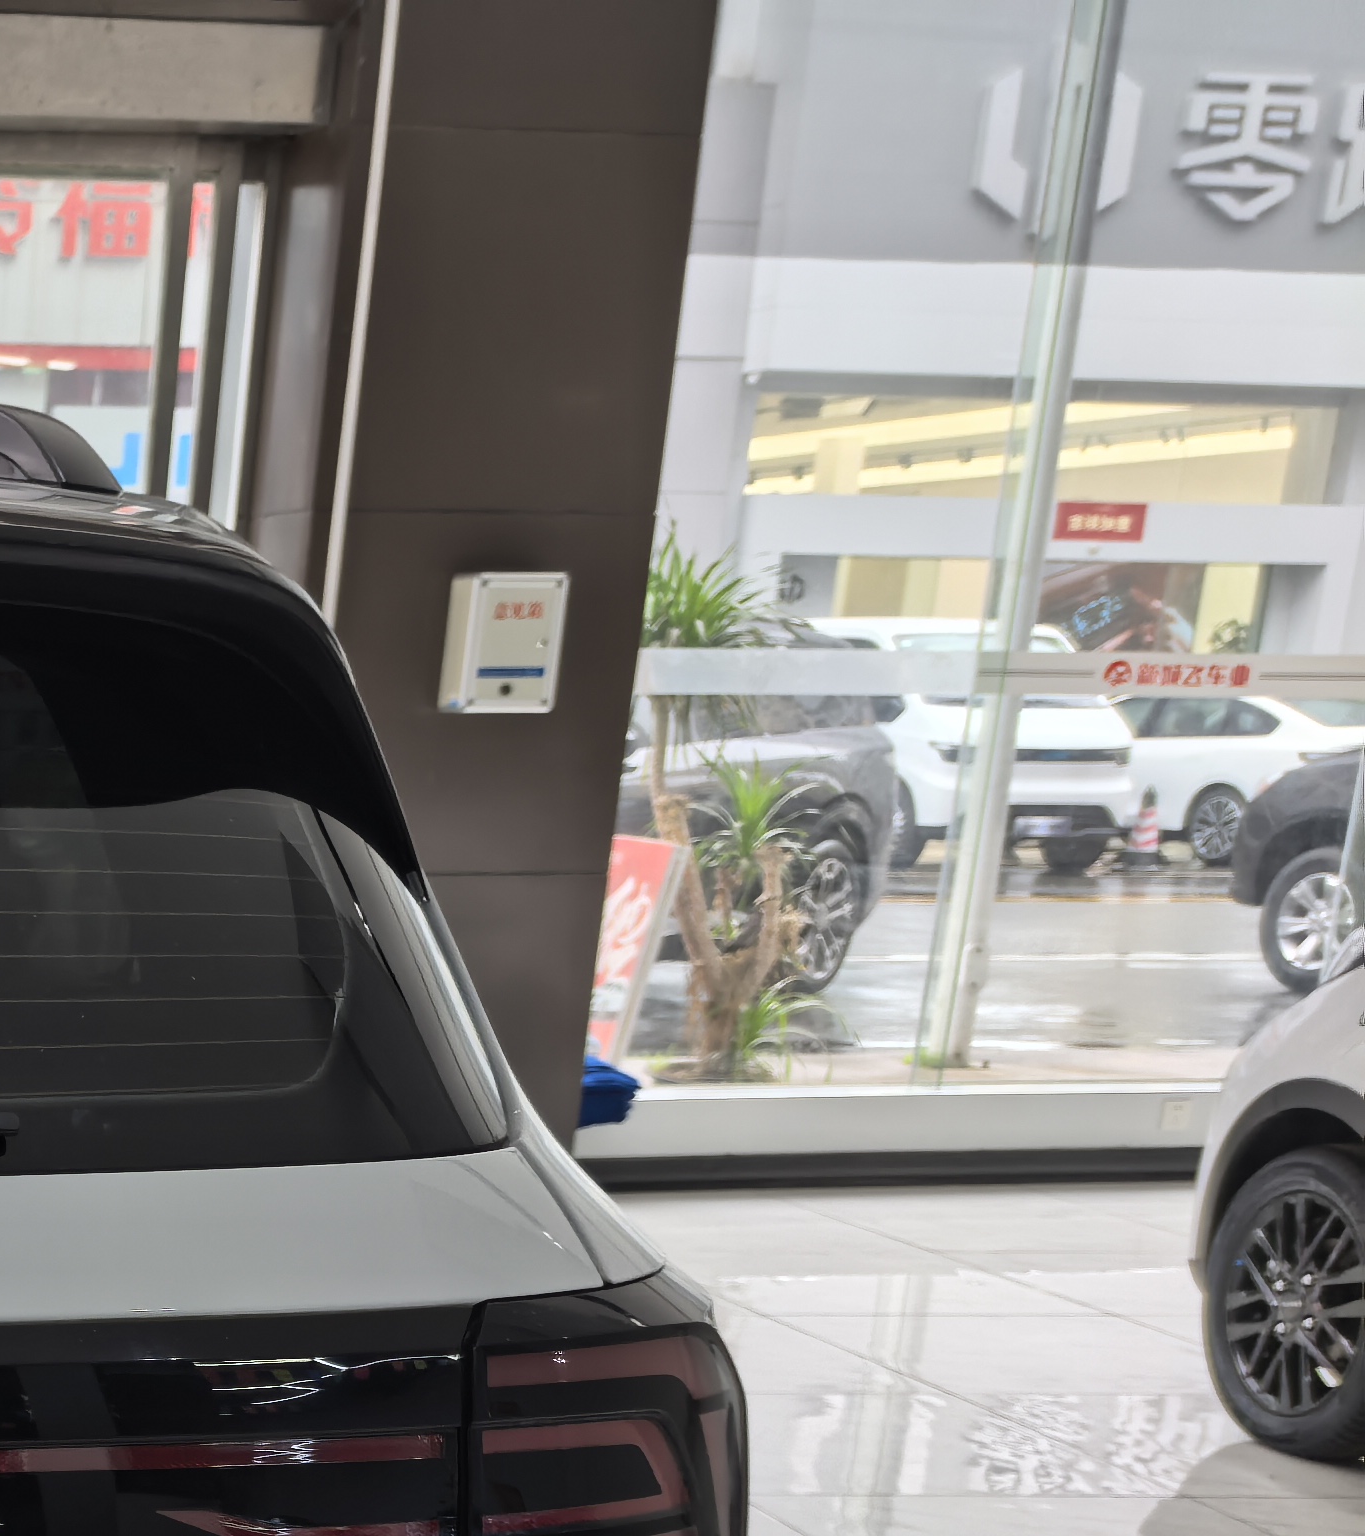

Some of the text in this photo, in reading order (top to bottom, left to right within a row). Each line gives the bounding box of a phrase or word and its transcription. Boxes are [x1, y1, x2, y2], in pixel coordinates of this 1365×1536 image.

[1177, 72, 1365, 225] 零
[1136, 663, 1251, 688] 新城飞车业
